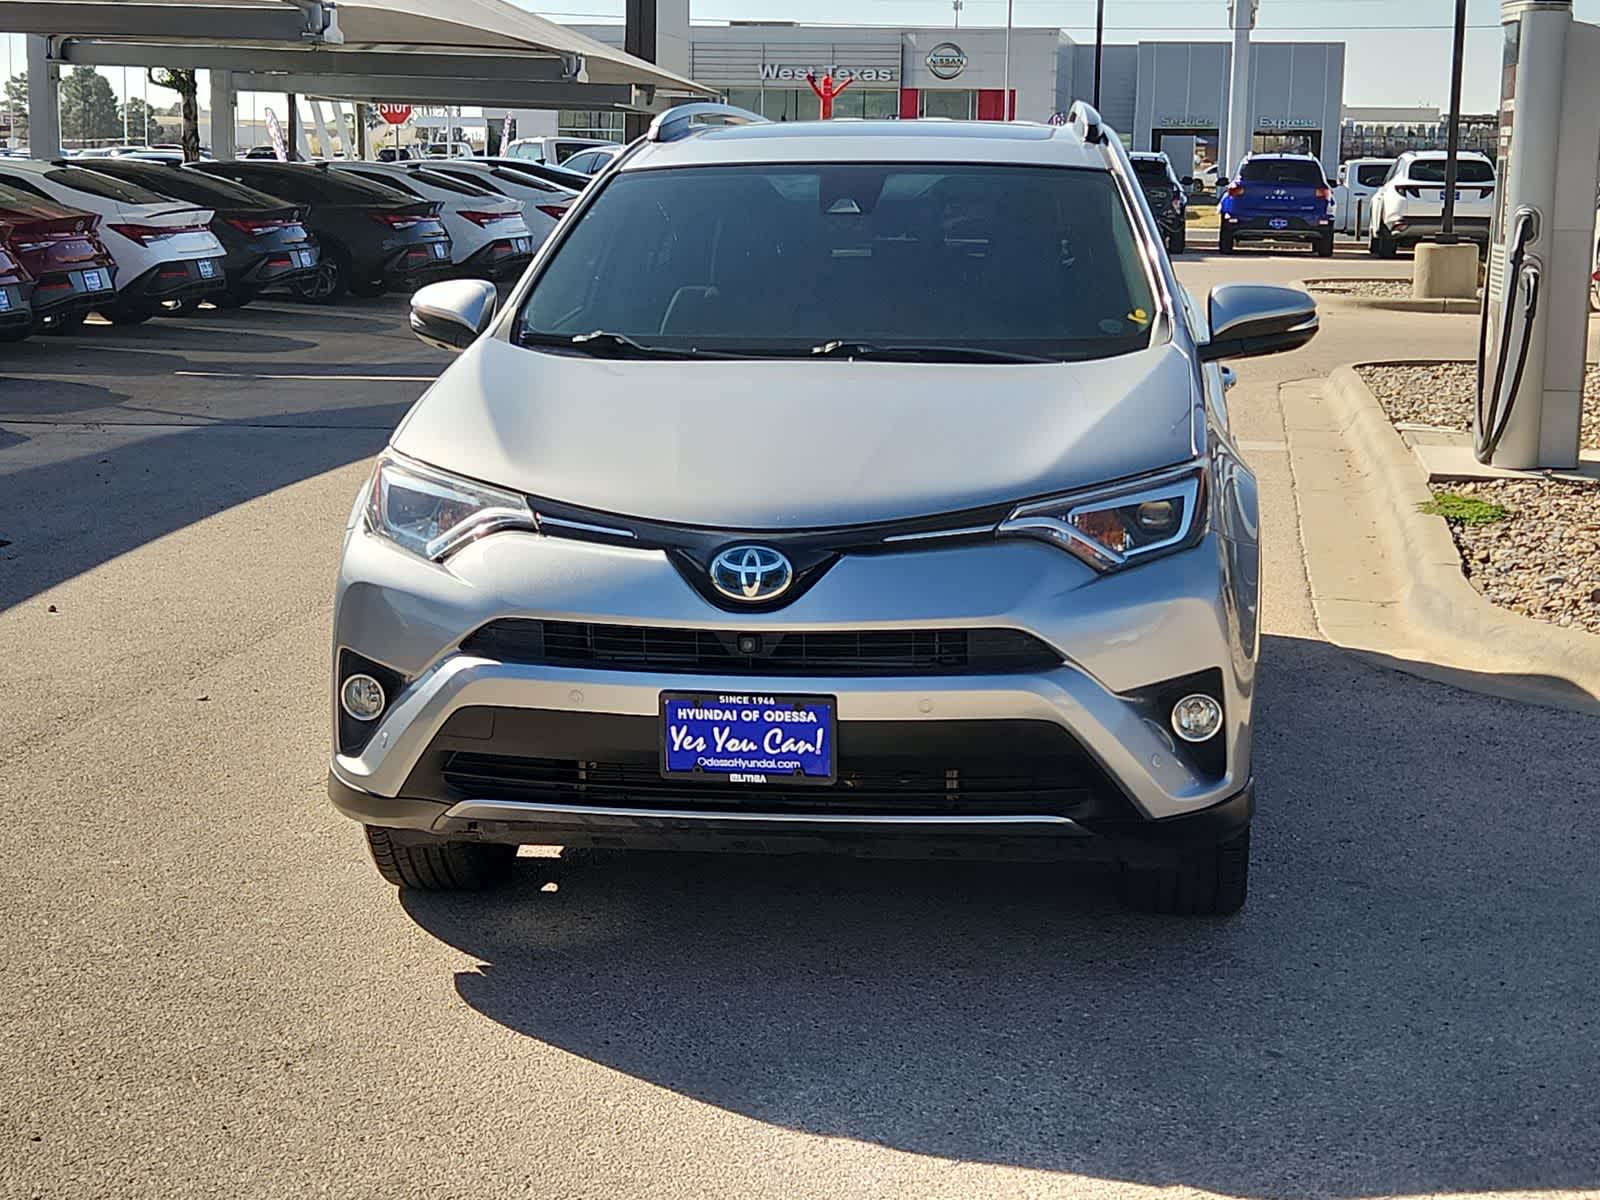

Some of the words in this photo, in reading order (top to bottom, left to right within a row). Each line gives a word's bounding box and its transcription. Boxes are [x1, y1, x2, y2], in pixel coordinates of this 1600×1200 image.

[929, 57, 964, 66] NISSAN
[759, 65, 815, 80] West
[823, 65, 892, 81] Texas
[719, 695, 749, 704] SINCE
[677, 708, 737, 721] HYUNDAI
[741, 712, 760, 722] OF
[763, 711, 817, 723] ODESSA
[670, 725, 706, 752] Yes
[713, 726, 758, 752] You
[763, 727, 824, 755] Can!
[697, 756, 801, 769] OdessaHyundai.com
